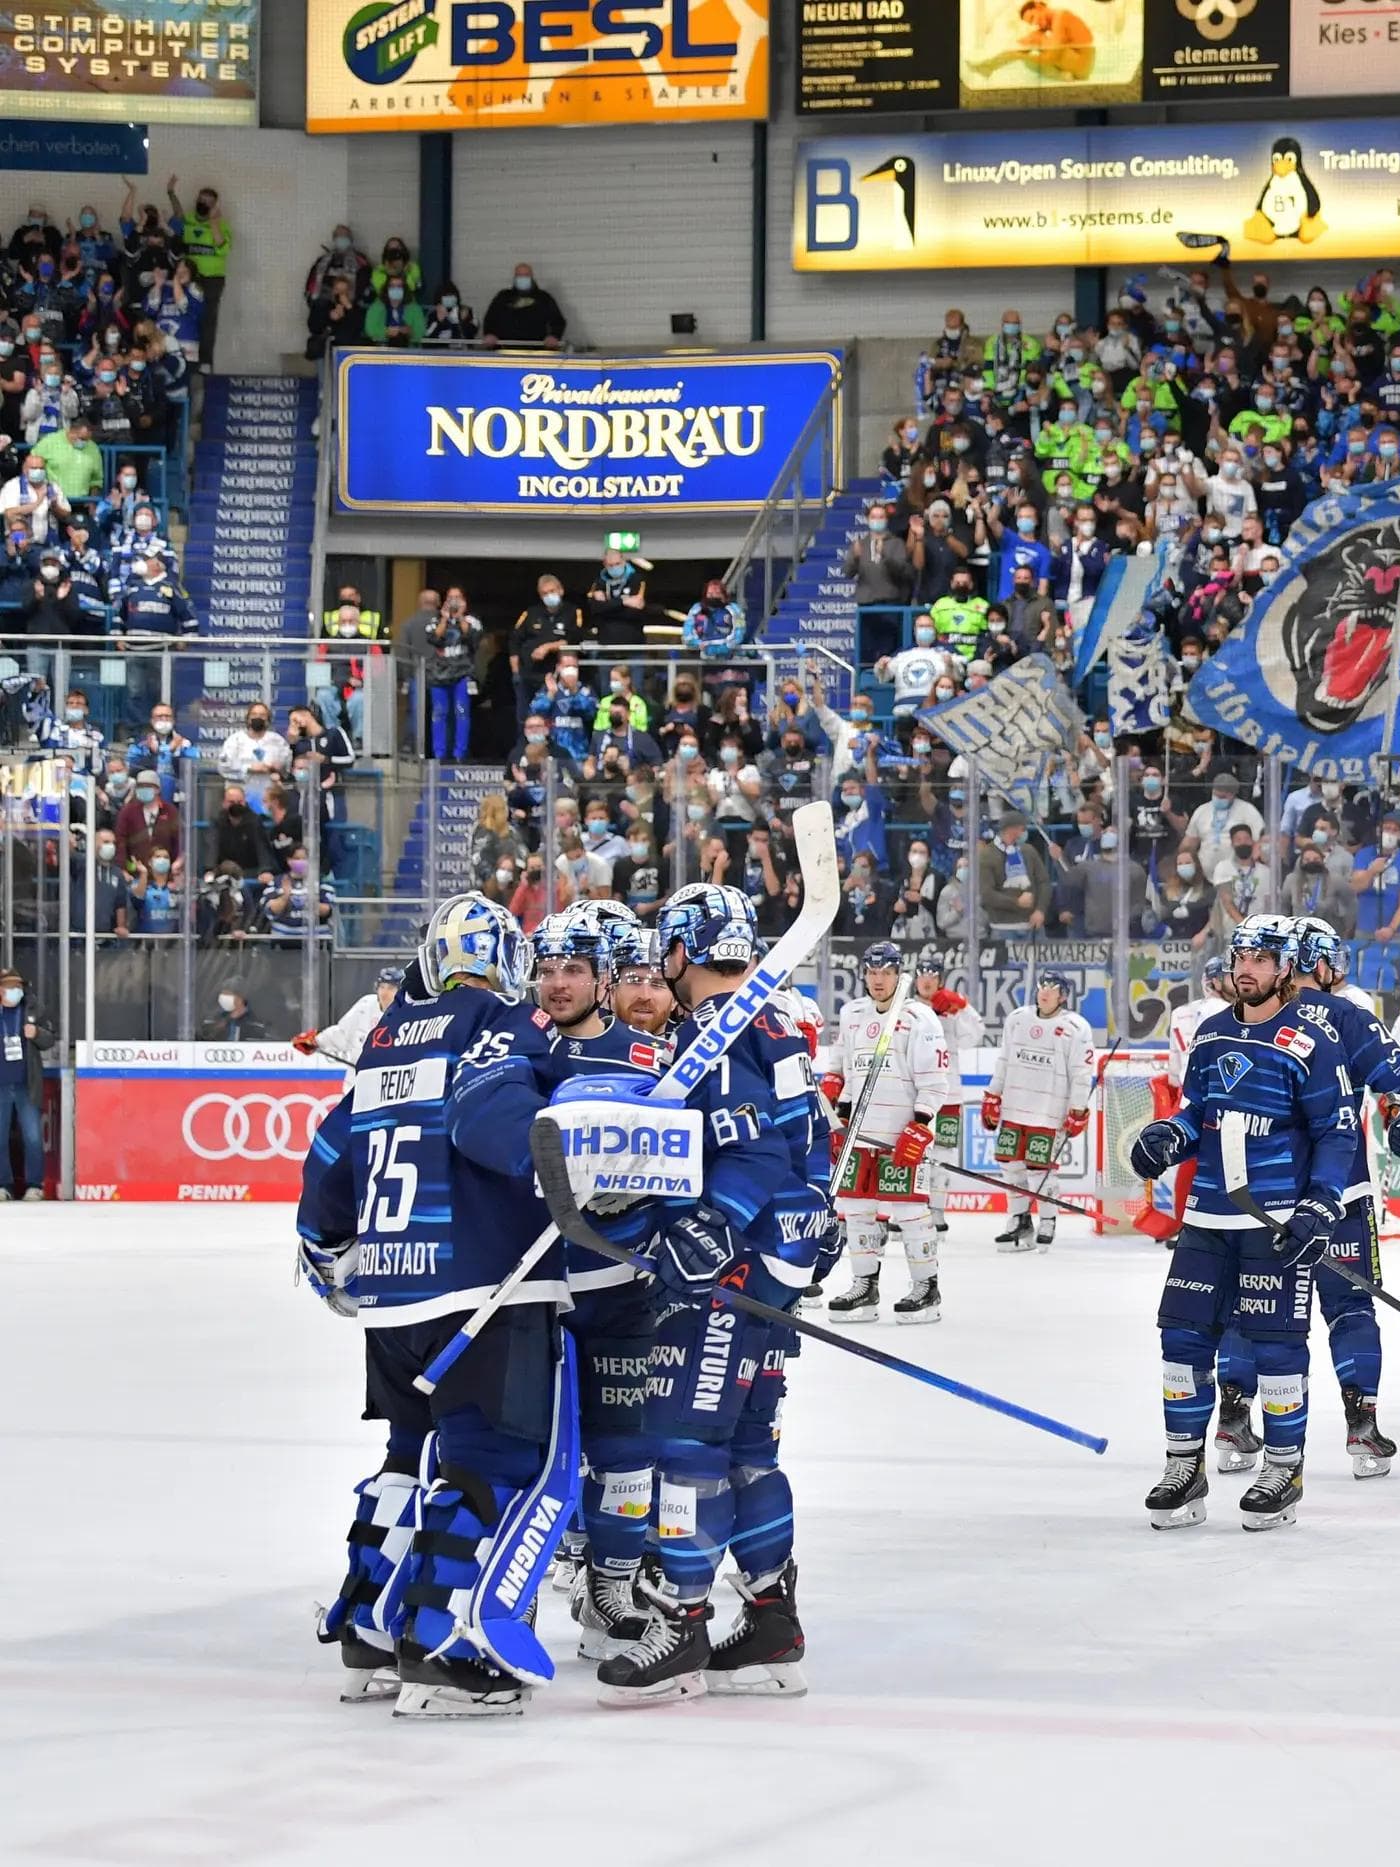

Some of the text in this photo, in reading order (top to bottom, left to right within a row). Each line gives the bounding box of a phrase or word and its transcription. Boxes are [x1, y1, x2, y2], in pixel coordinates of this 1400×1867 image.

[803, 3, 863, 22] NEUEN
[14, 14, 249, 39] STRÖHMER
[450, 0, 738, 66] BESL
[1319, 24, 1366, 45] Kies
[14, 35, 250, 60] COMPUTER
[388, 24, 427, 62] LIFT
[1174, 46, 1258, 64] elements
[25, 56, 237, 80] SYSTEME
[350, 90, 571, 110] ARBEITSBÜHNEN
[625, 86, 739, 101] STAPLER
[943, 154, 1239, 184] Linux/Open Source Consulting,
[519, 373, 684, 404] Privatbrauerei
[425, 402, 765, 470] NORDBRÄU
[517, 474, 684, 498] INGOLSTADT
[394, 1015, 455, 1048] SATURN
[673, 966, 787, 1089] BÜCHL
[136, 1048, 178, 1062] Audi
[252, 1048, 294, 1062] Audi
[936, 1049, 949, 1069] 15
[380, 1071, 416, 1101] REICH
[594, 1174, 691, 1192] VAUGHN
[879, 1178, 908, 1193] Bank
[1166, 1278, 1215, 1293] BAUER
[692, 1310, 736, 1412] SATURN
[495, 1494, 564, 1610] VAUGHN
